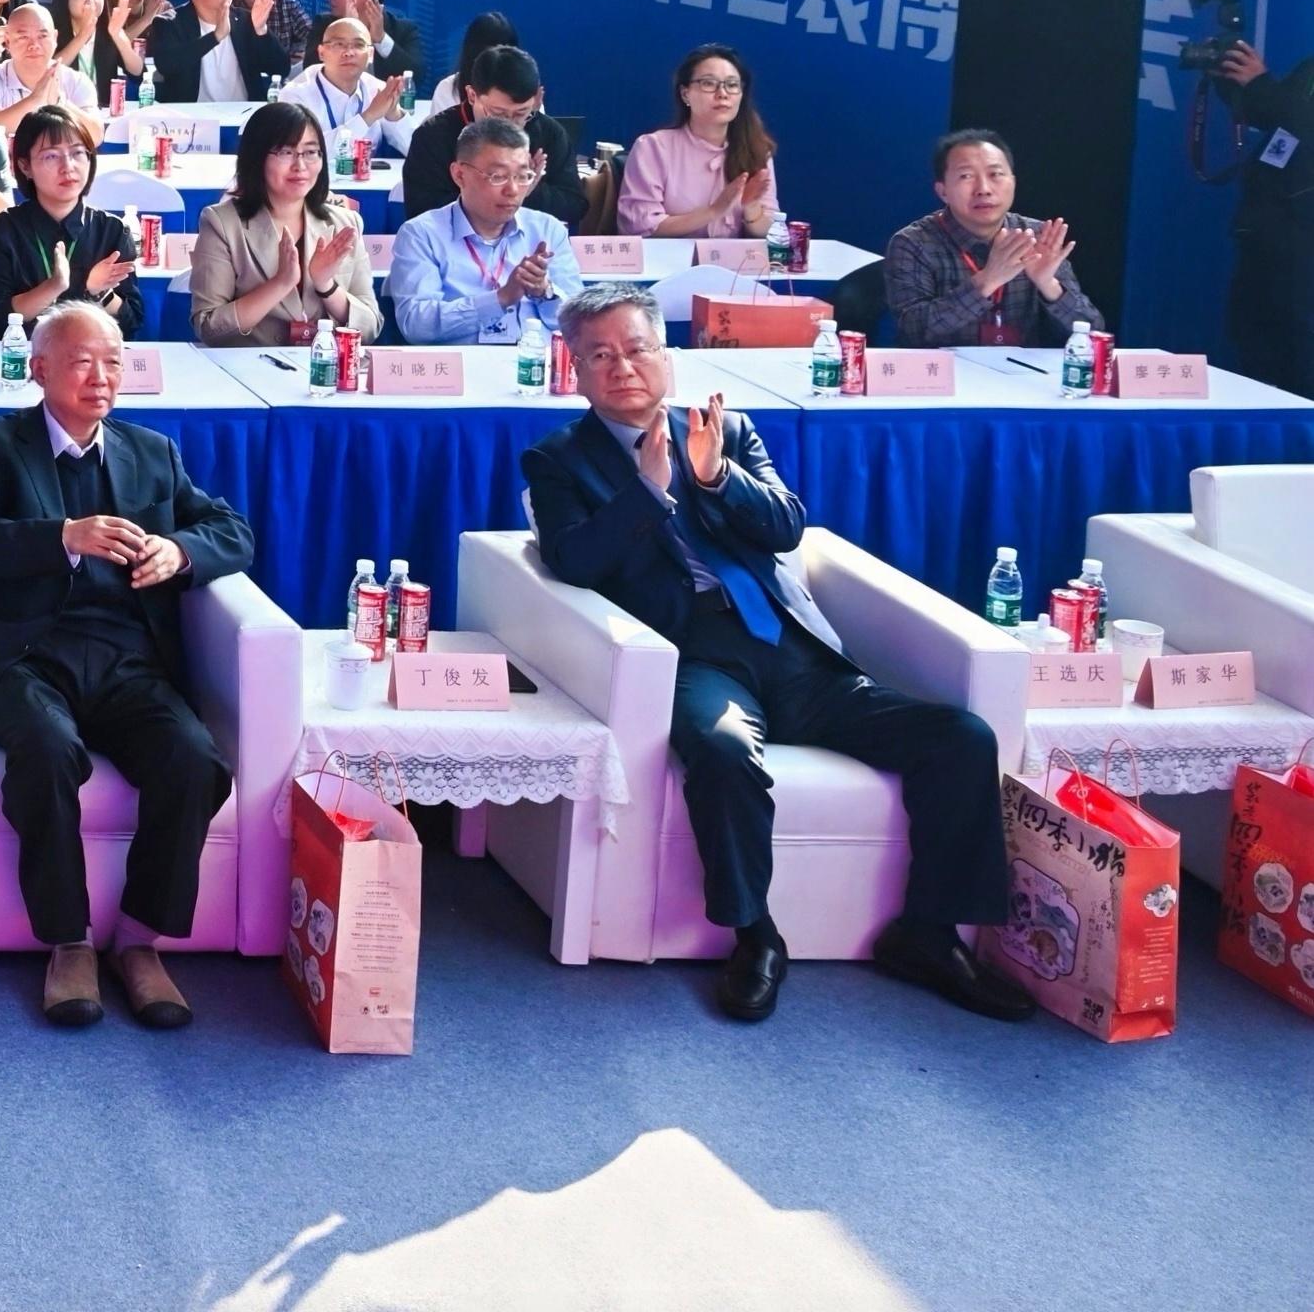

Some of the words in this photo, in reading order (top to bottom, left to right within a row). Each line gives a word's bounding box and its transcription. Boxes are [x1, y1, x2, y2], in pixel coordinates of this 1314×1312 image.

[389, 362, 449, 377] 刘晓庆
[414, 668, 490, 687] 丁俊发
[1033, 663, 1106, 683] 王选庆
[1170, 664, 1238, 686] 斯家华
